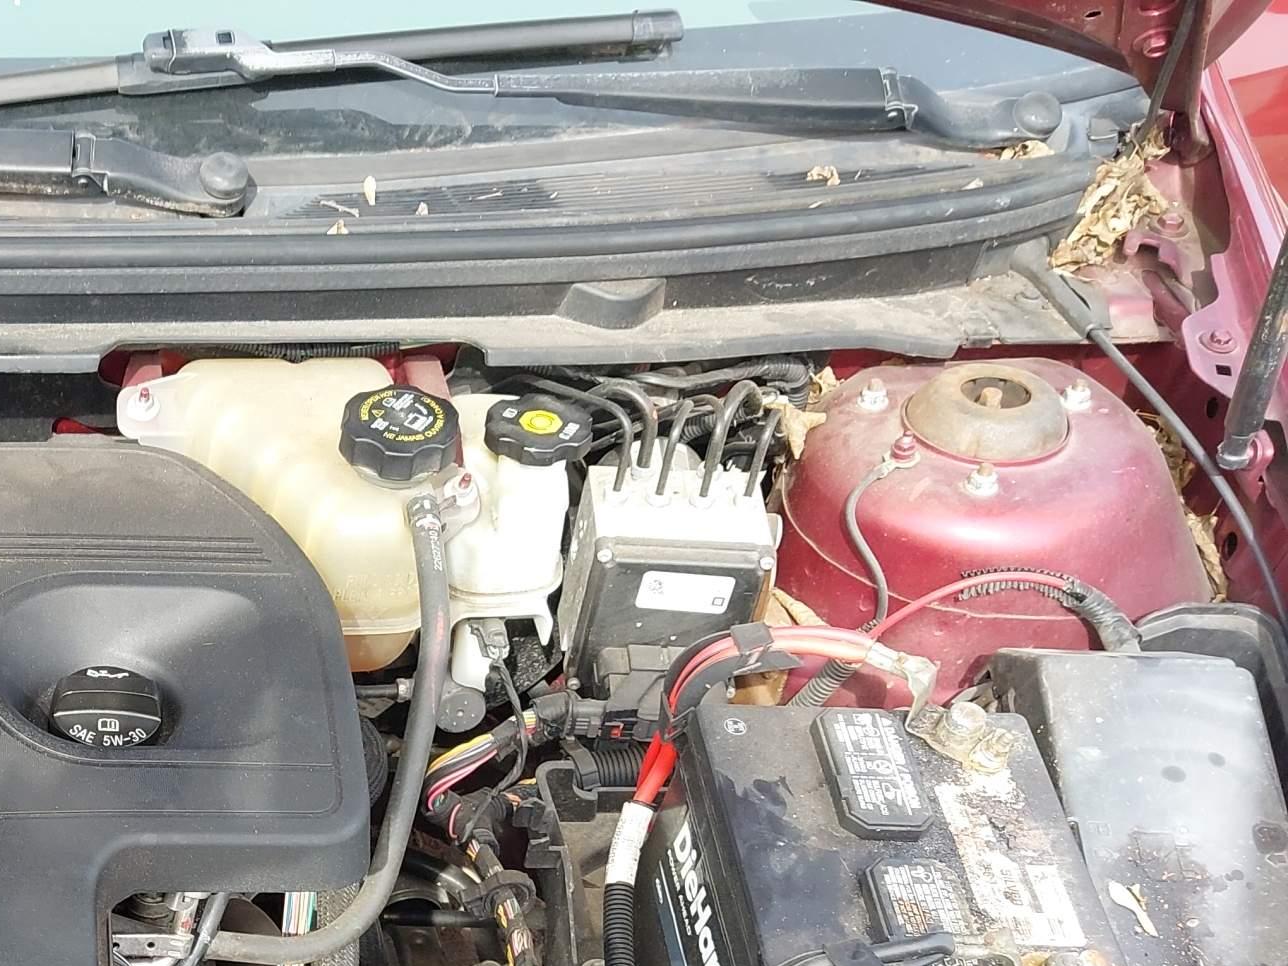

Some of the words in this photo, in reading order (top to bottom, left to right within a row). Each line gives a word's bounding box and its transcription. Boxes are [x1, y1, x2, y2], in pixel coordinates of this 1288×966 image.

[69, 724, 97, 744] SAE
[102, 728, 147, 747] 5W-30
[667, 849, 680, 892] POWER
[678, 894, 691, 936] AHEAD
